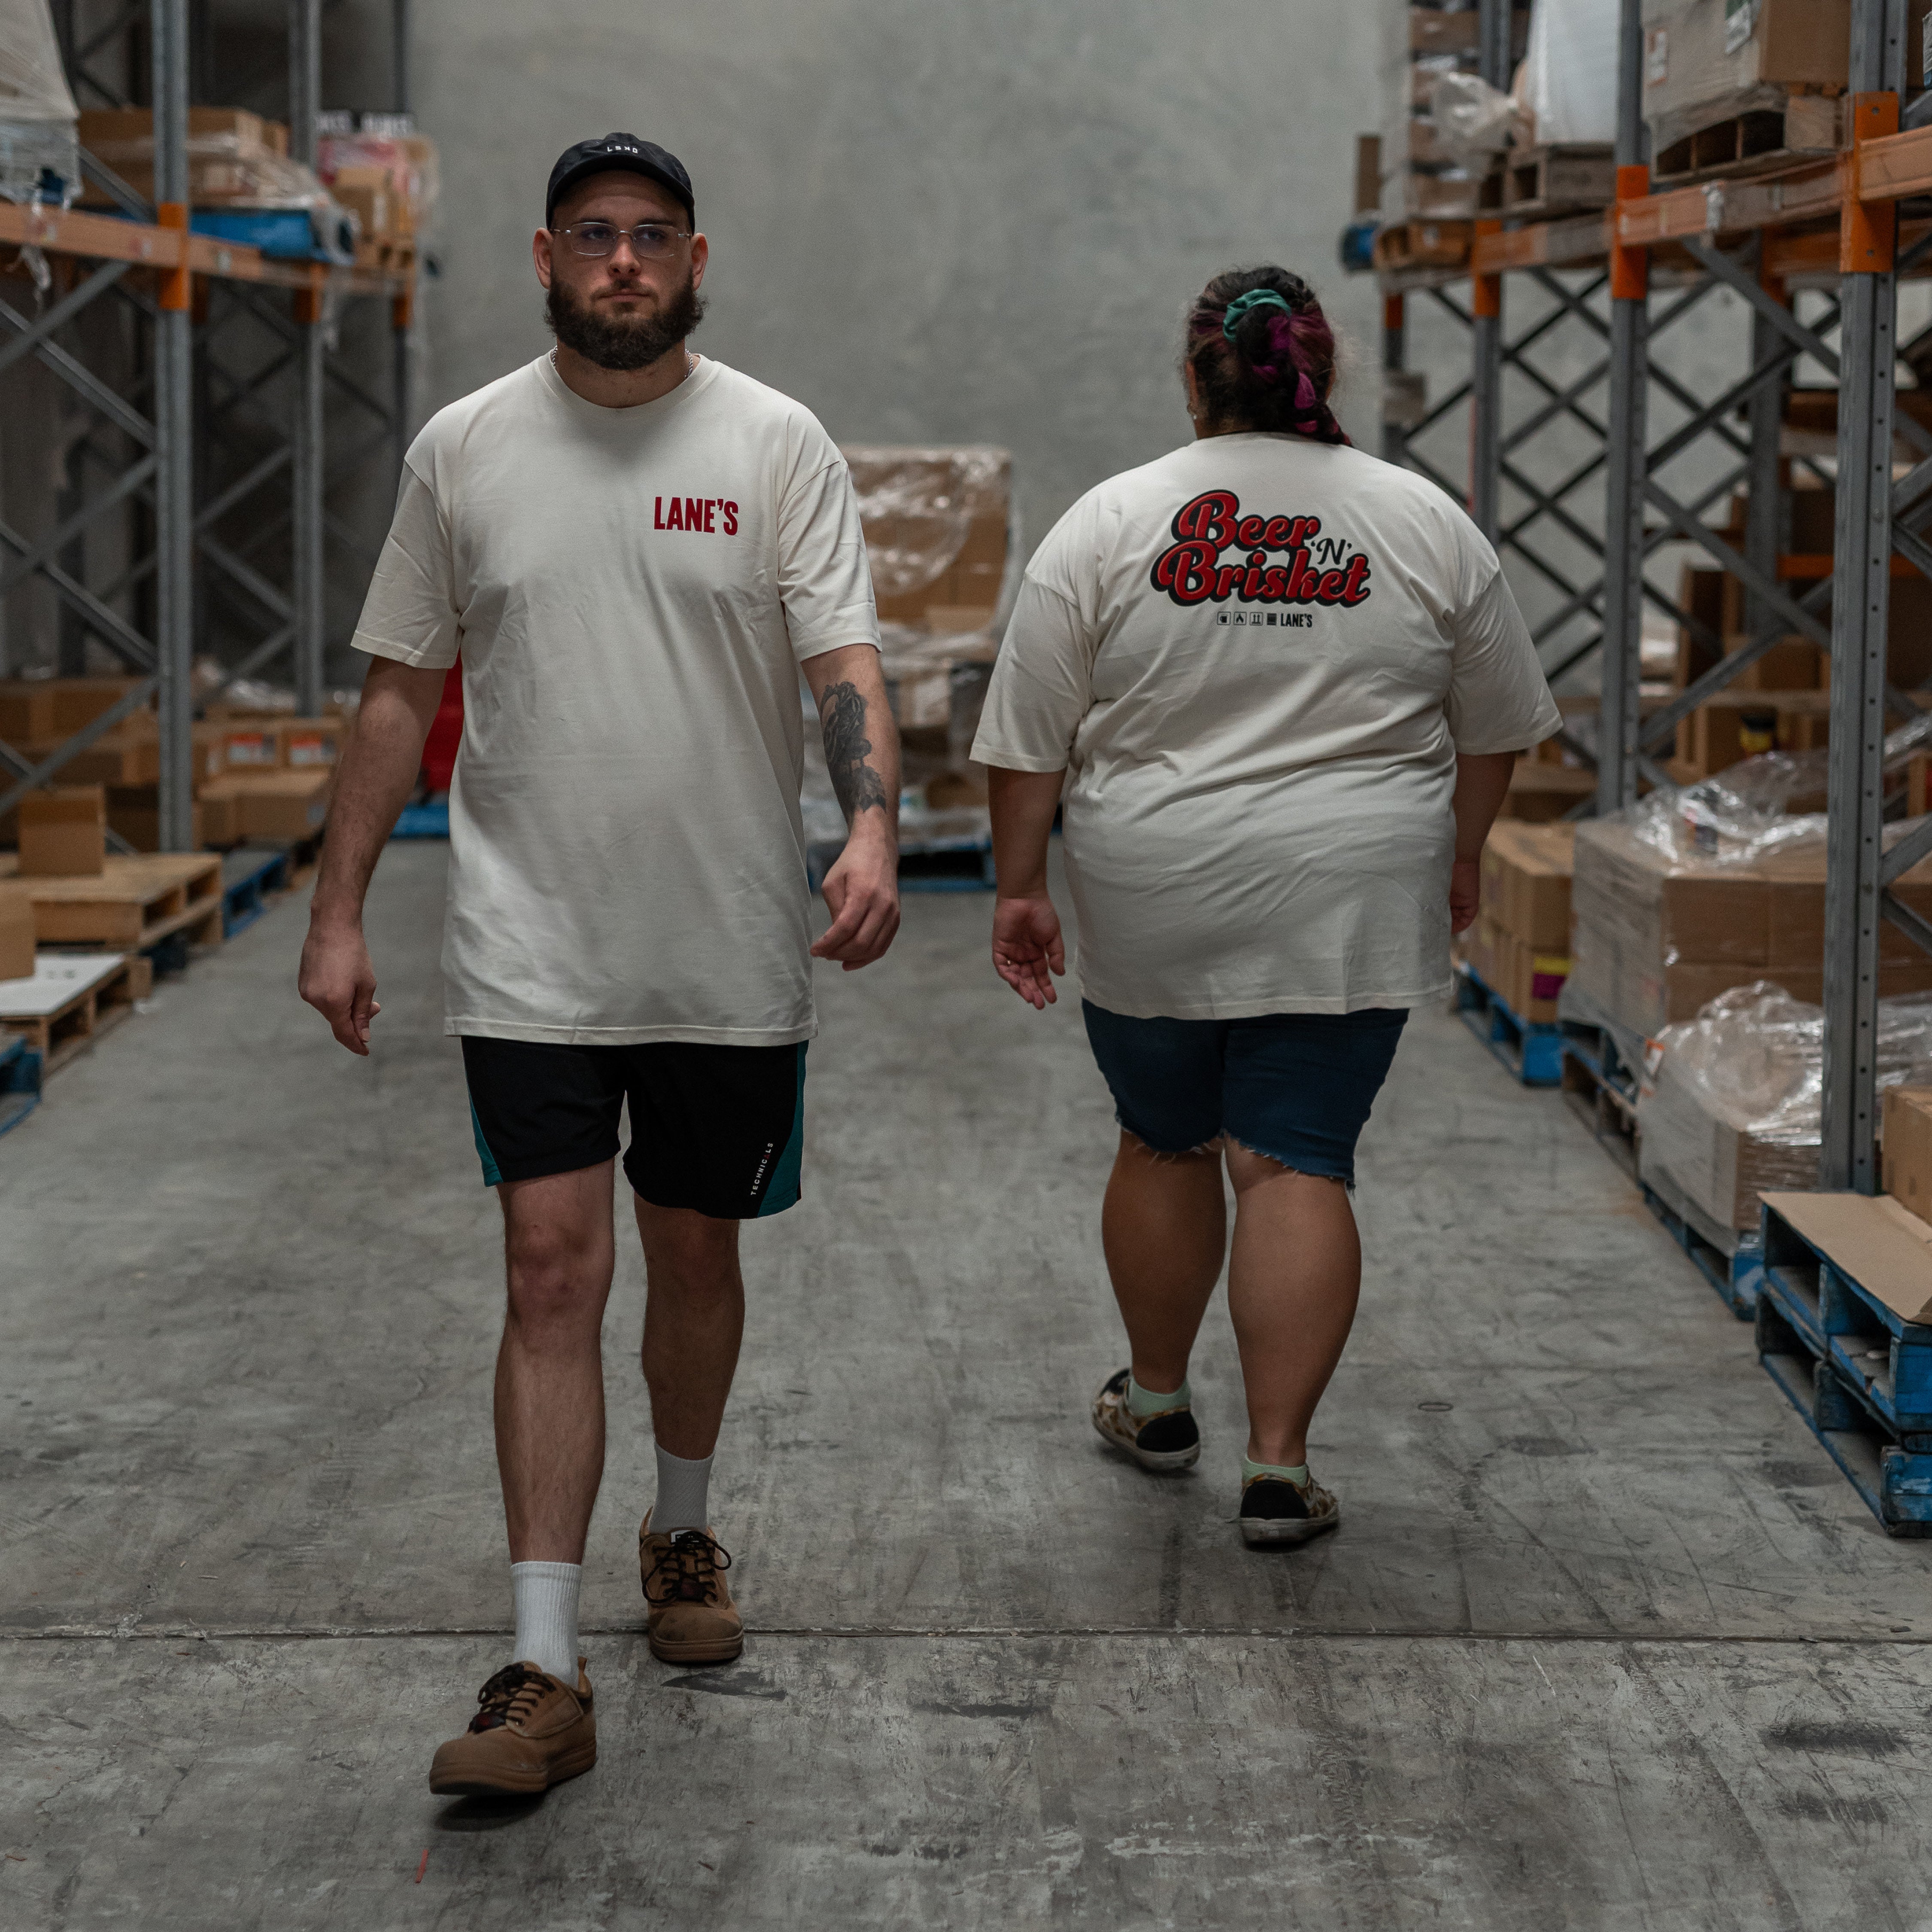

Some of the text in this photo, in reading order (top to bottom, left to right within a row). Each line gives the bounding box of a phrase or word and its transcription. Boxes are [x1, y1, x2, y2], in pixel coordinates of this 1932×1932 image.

[654, 496, 738, 536] LANE'S
[1172, 489, 1321, 553] Beer
[1150, 538, 1371, 608] Brisket
[1281, 613, 1312, 628] LANE'S
[750, 1142, 773, 1195] TECHNICALS
